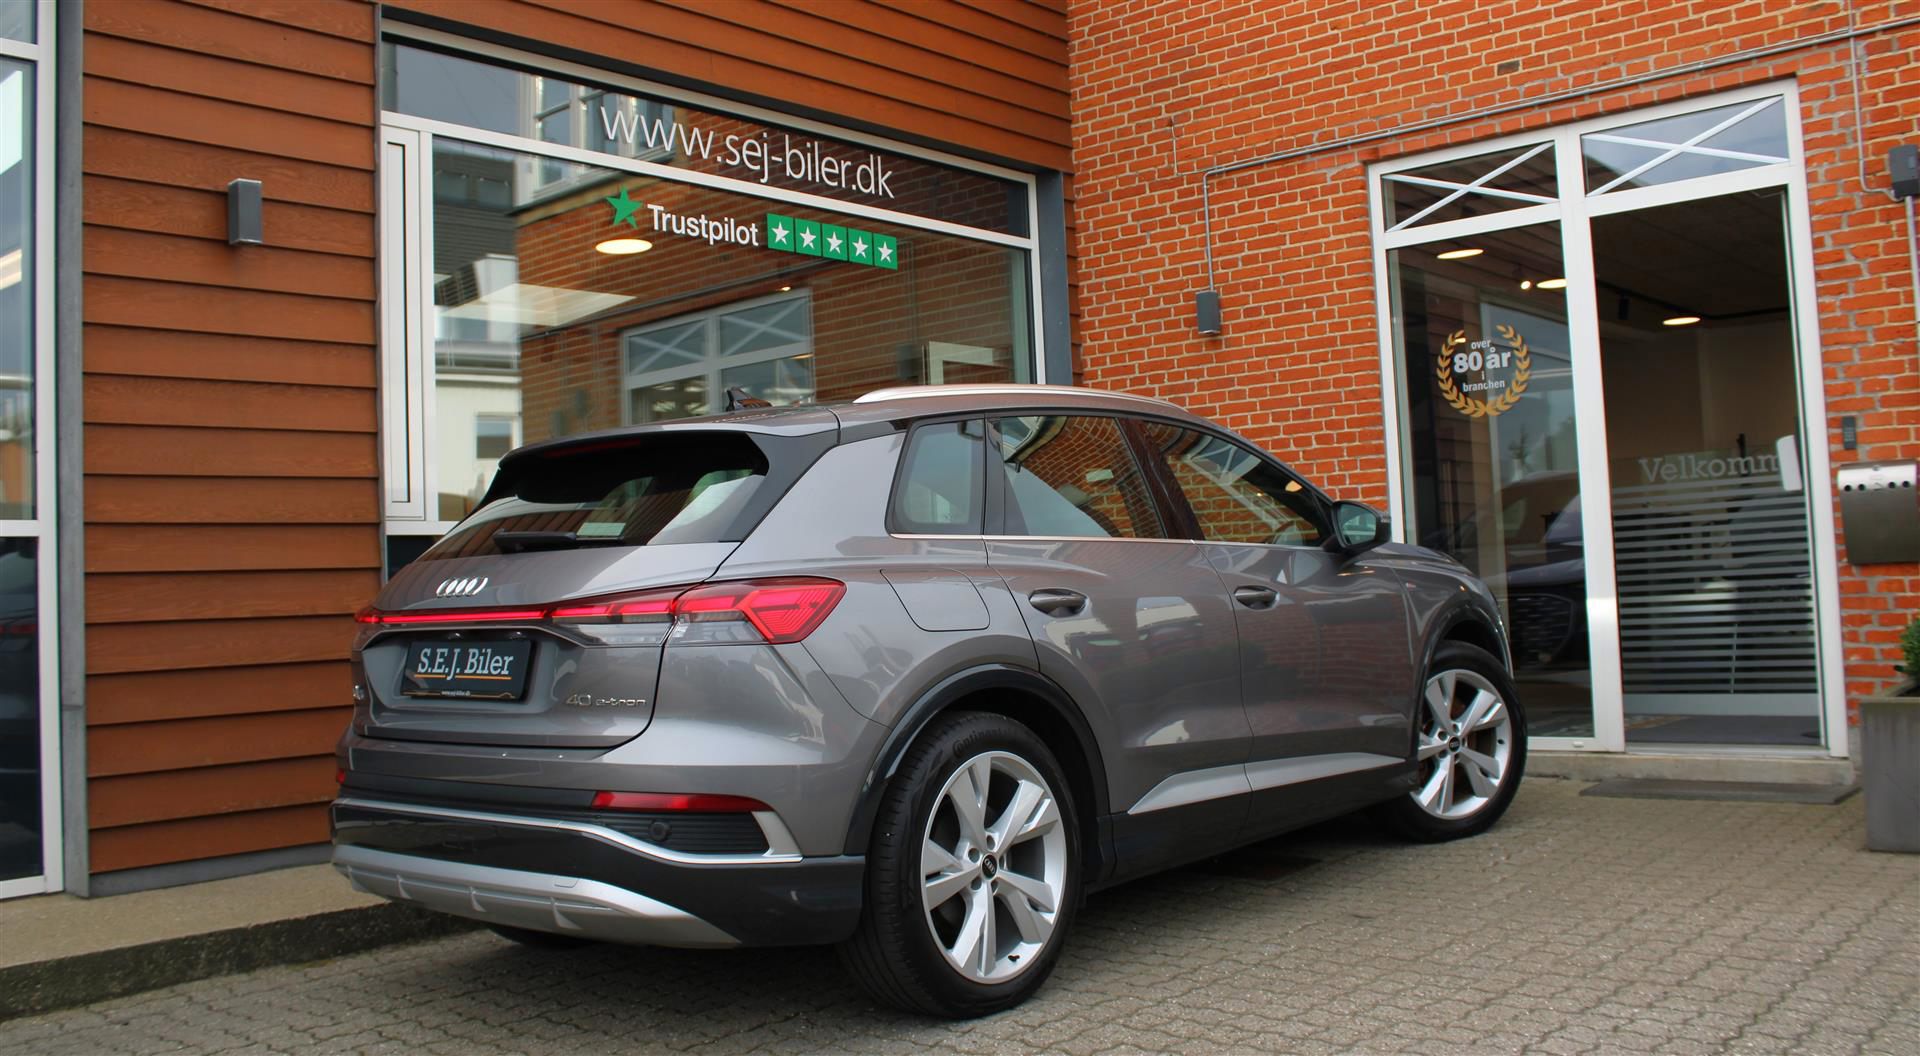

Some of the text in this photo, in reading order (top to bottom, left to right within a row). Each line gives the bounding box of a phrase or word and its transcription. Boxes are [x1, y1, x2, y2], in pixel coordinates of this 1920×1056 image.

[601, 105, 895, 199] www.sej-biler.dk
[647, 204, 759, 247] Trustpilot
[1471, 339, 1491, 350] over
[1453, 346, 1511, 373] 80 år
[1462, 380, 1505, 392] branchen
[417, 647, 514, 681] S.E.J. Biler
[566, 694, 646, 706] 40 e-tron
